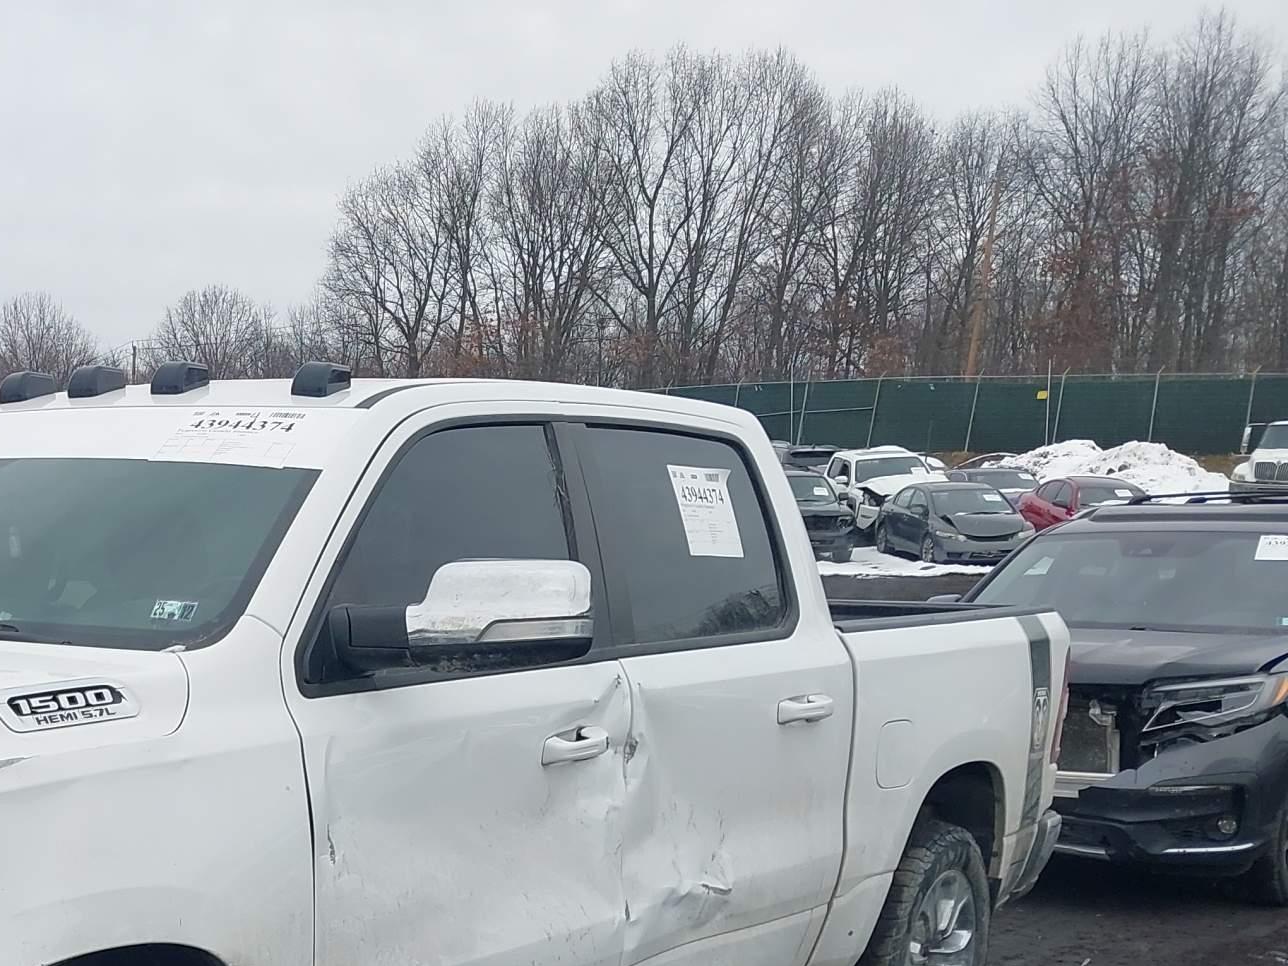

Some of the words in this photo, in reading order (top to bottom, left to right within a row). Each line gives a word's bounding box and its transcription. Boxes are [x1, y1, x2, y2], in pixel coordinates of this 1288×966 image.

[190, 419, 296, 432] 43944374
[681, 486, 724, 504] 43944374
[13, 688, 113, 715] 1500
[36, 712, 78, 725] HEMI
[81, 708, 116, 719] 5.7L
